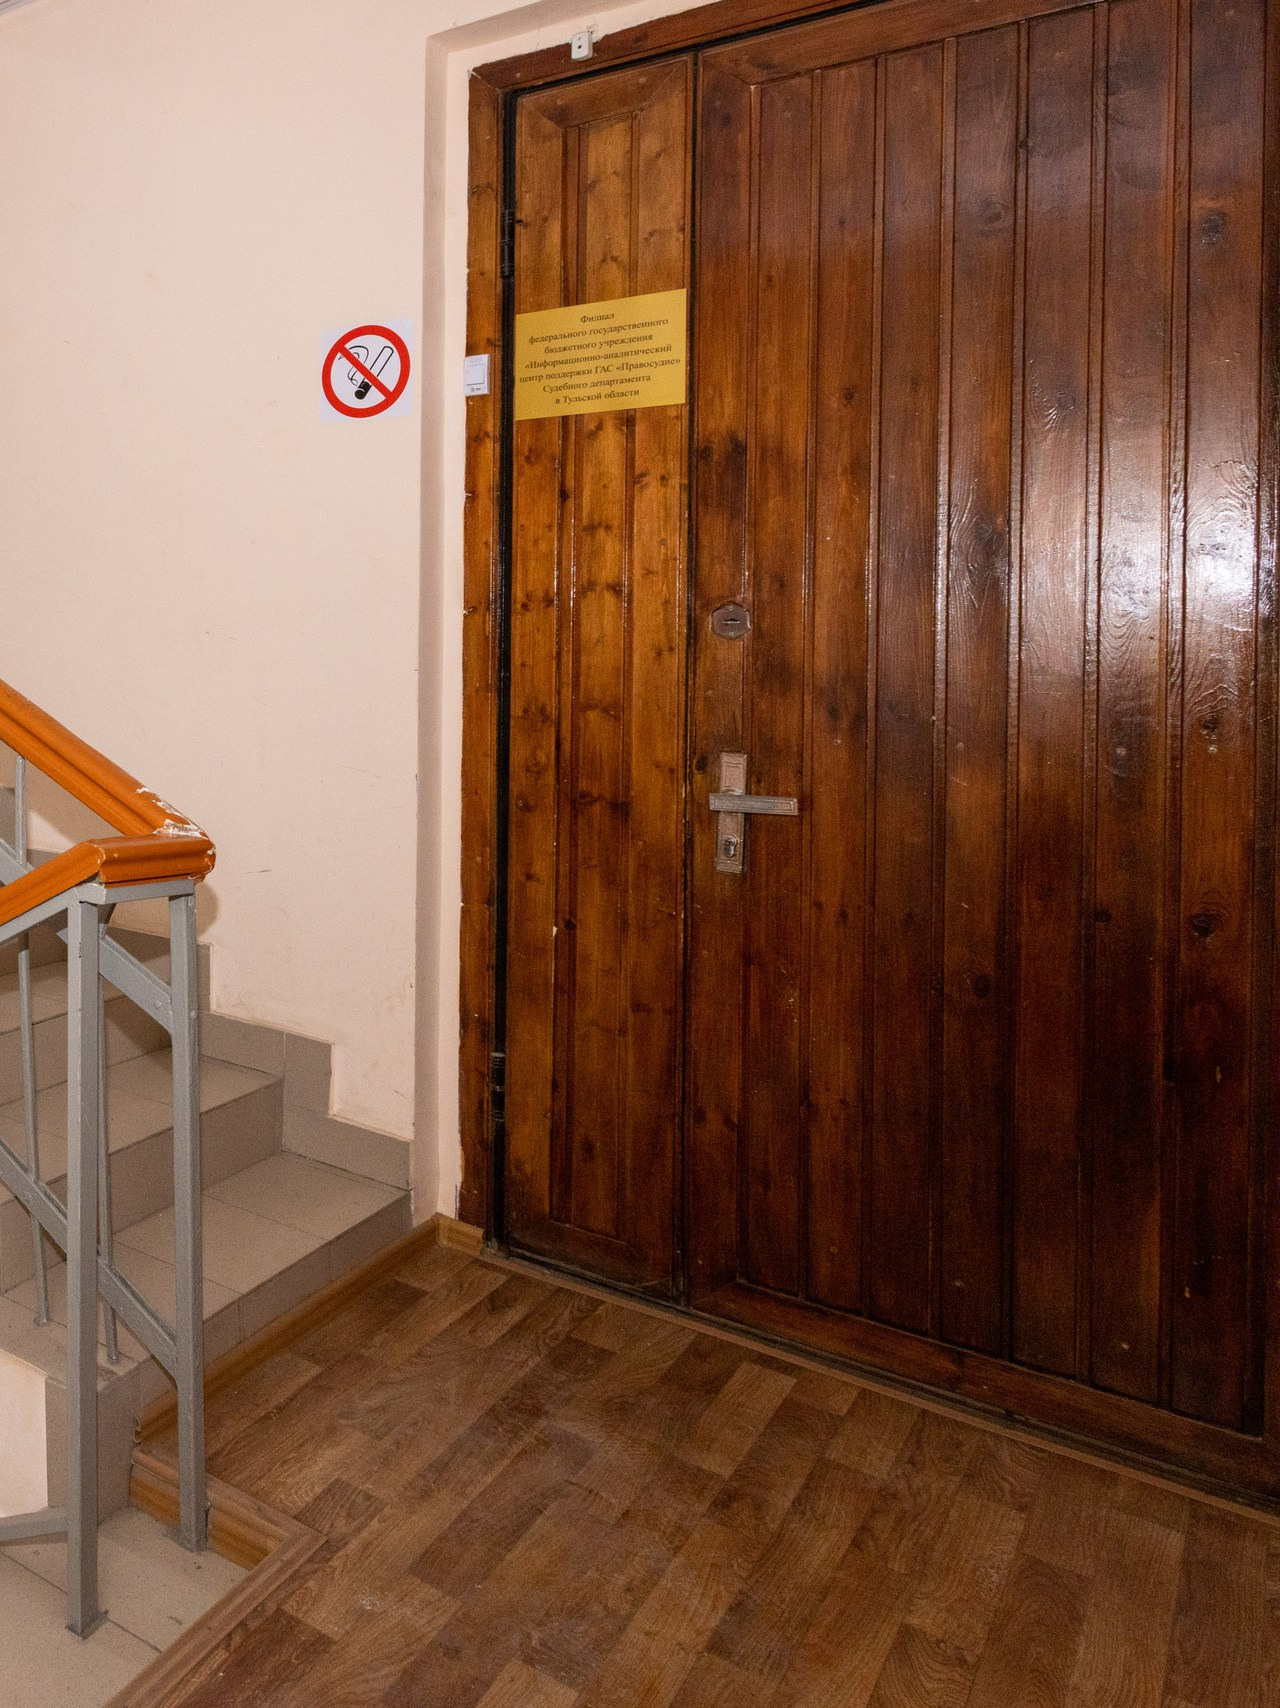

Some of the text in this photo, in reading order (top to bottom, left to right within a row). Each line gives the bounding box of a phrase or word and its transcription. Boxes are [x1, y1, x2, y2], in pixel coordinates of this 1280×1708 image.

[580, 313, 615, 323] Филиал
[528, 319, 669, 345] федерального государственного
[544, 334, 653, 354] бюджетного учреждения
[525, 344, 672, 369] «Информационно-аналитический
[519, 359, 681, 383] центр поддержки ГАС «Правосудие»
[543, 375, 651, 394] Судебного департамента
[562, 393, 602, 405] Тульской
[604, 389, 640, 399] области
